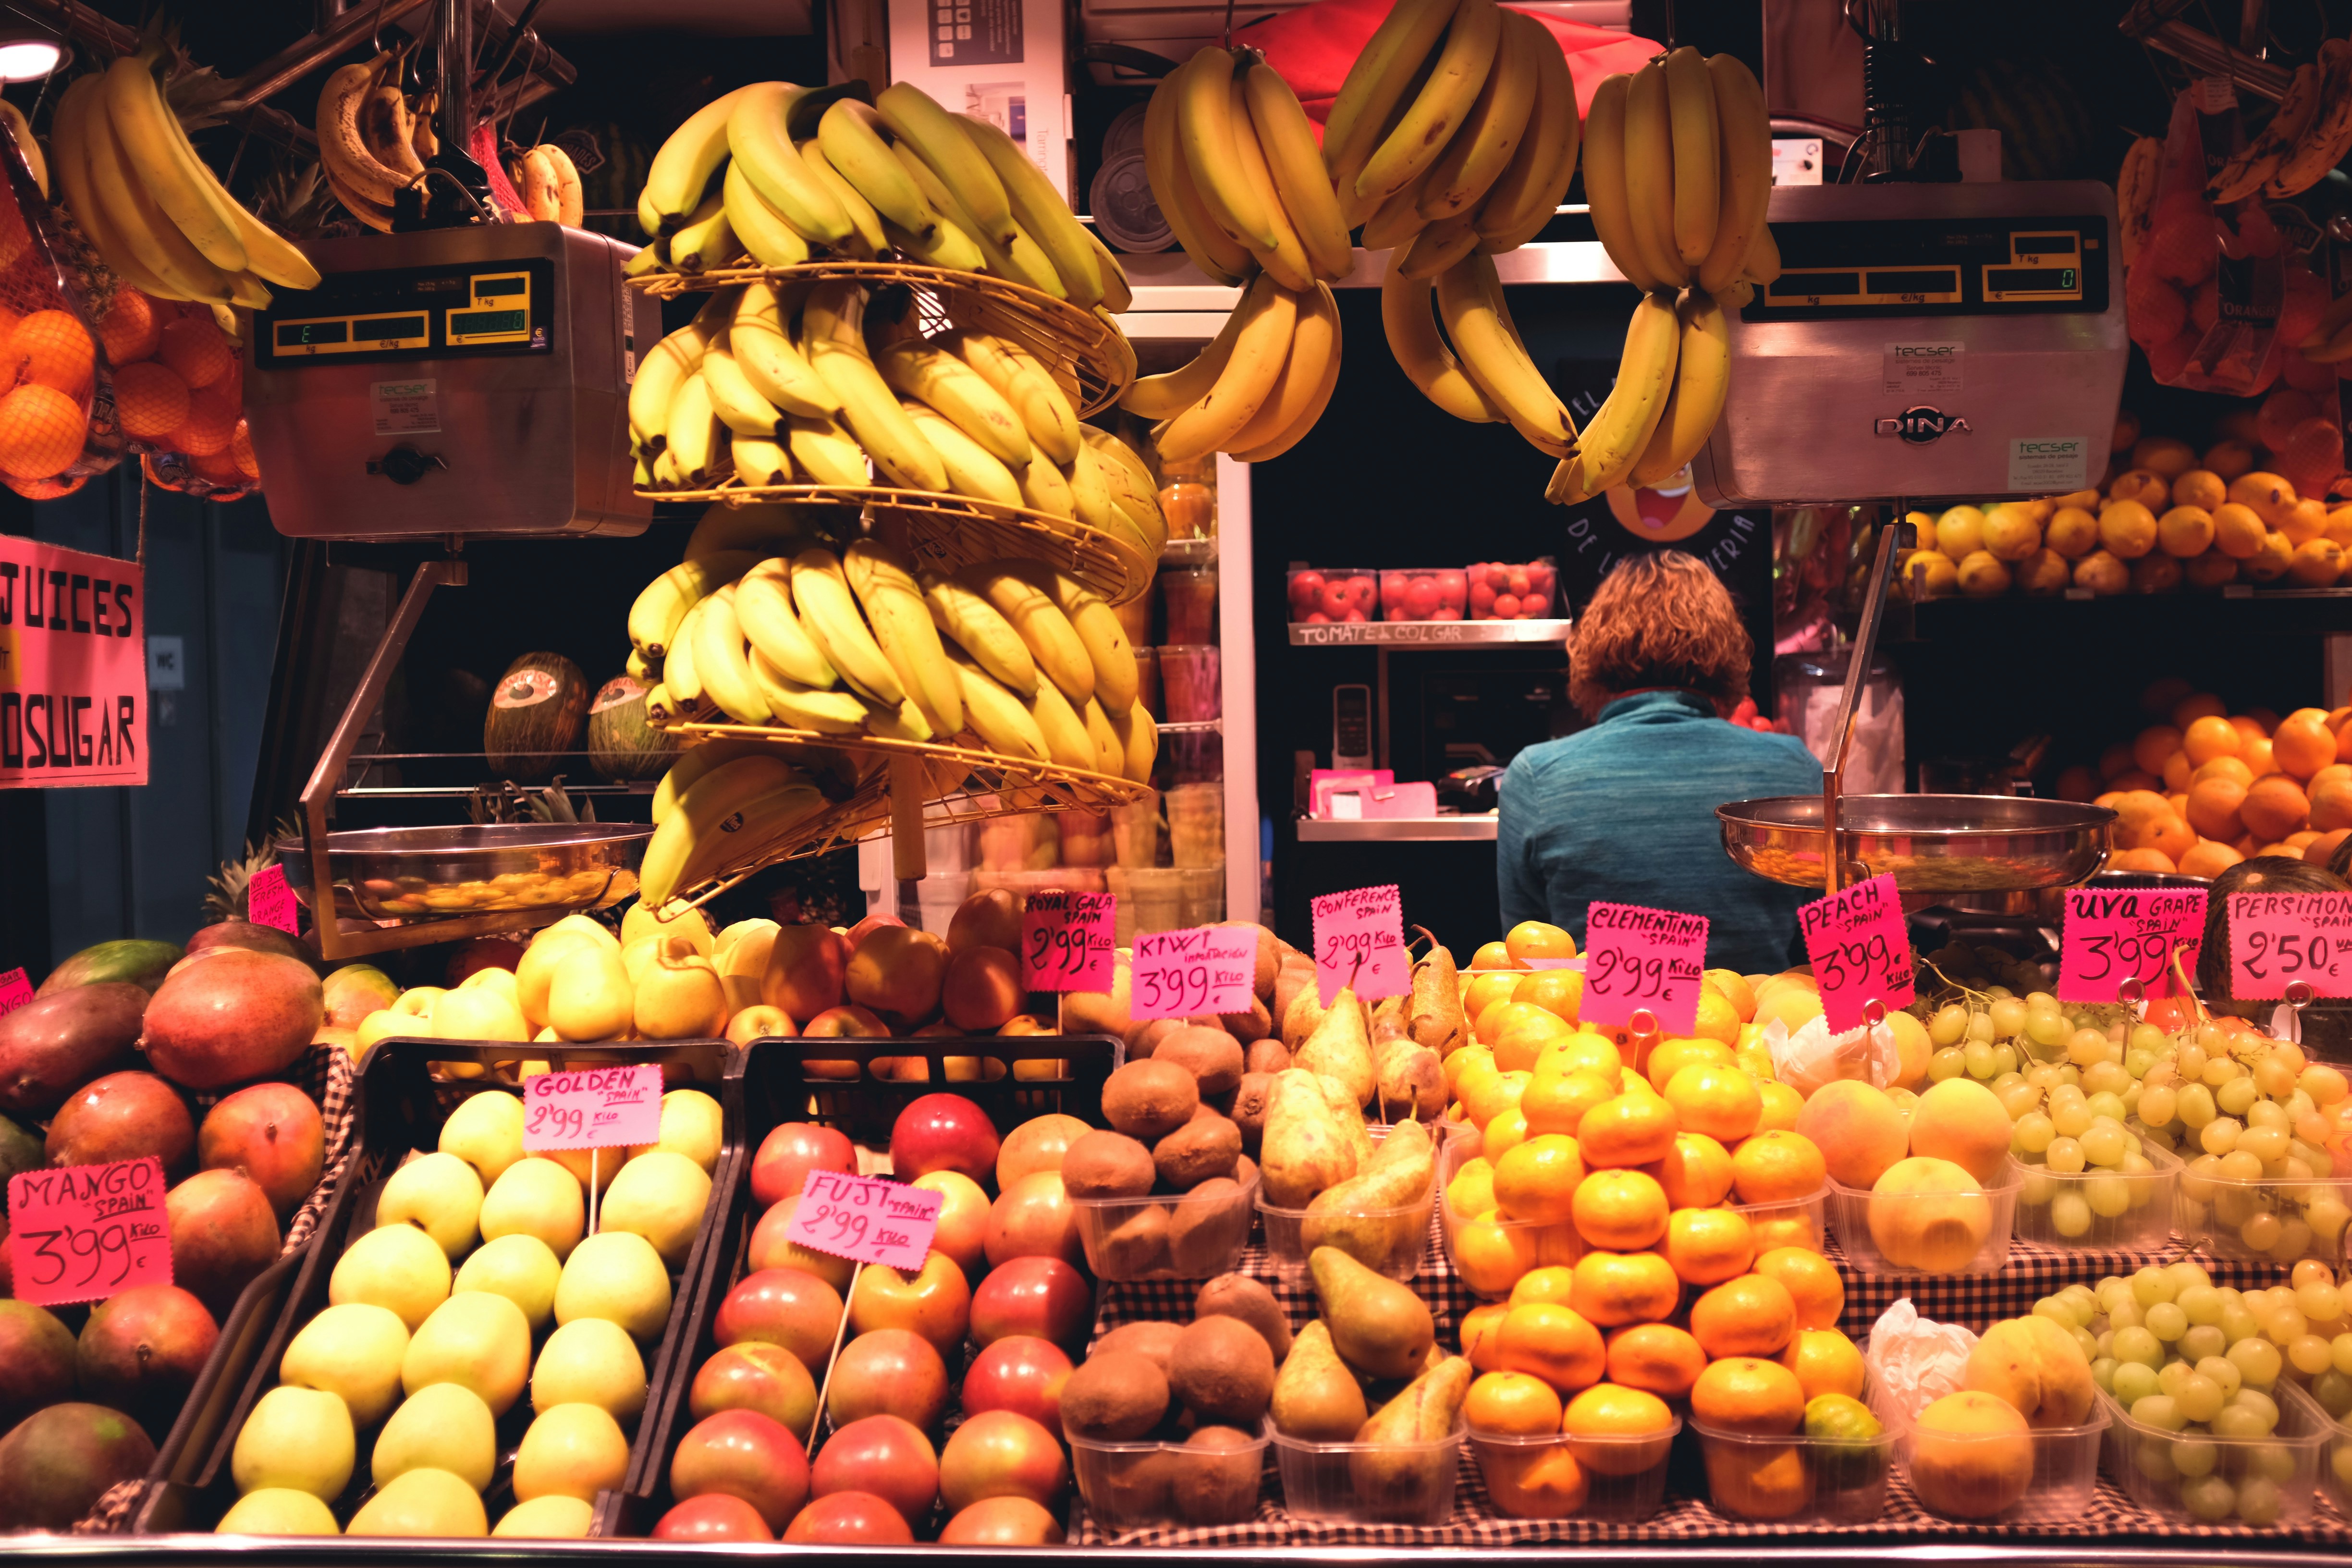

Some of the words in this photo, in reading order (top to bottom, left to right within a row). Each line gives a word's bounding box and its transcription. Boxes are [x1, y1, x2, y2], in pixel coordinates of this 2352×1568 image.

[2028, 256, 2038, 264] kg
[2062, 270, 2074, 287] 0
[485, 298, 494, 307] kg
[1808, 295, 1819, 305] kg
[1901, 293, 1924, 303] €/kg
[2224, 301, 2276, 317] ORANGES
[306, 345, 316, 354] kg
[380, 340, 399, 349] €/kg
[1895, 345, 1955, 356] tecser
[379, 384, 428, 395] tecser
[1571, 390, 1602, 416] EL
[1875, 417, 1972, 434] DINA
[2020, 442, 2079, 453] tecser
[1567, 517, 1598, 554] DE
[0, 562, 133, 638] JUICES
[250, 877, 262, 893] NO
[253, 884, 283, 907] FRESH
[251, 898, 285, 923] ORANGE
[1026, 895, 1069, 912] ROYAL
[1075, 894, 1114, 911] GALA
[1317, 888, 1399, 918] CONFERENCE
[1804, 882, 1879, 936] PEACH
[2149, 894, 2204, 919] GRAPE
[1592, 907, 1704, 937] CLEMENTINA
[1029, 927, 1085, 975] 2'99
[1813, 934, 1890, 992] 3'99
[2079, 931, 2167, 986] 3'99
[2241, 931, 2328, 980] 2'50
[1090, 960, 1097, 971] €
[1372, 964, 1381, 974] €
[1590, 946, 1663, 998] 2'99
[2328, 963, 2339, 977] €
[1140, 966, 1208, 1012] 3'99
[1662, 988, 1673, 1002] €
[534, 1070, 636, 1098] GOLDEN
[525, 1102, 584, 1139] 2'99
[18, 1162, 151, 1210] MANGO
[807, 1176, 891, 1208] FUJI
[800, 1204, 869, 1249] 2'99
[19, 1224, 131, 1288] 3'99
